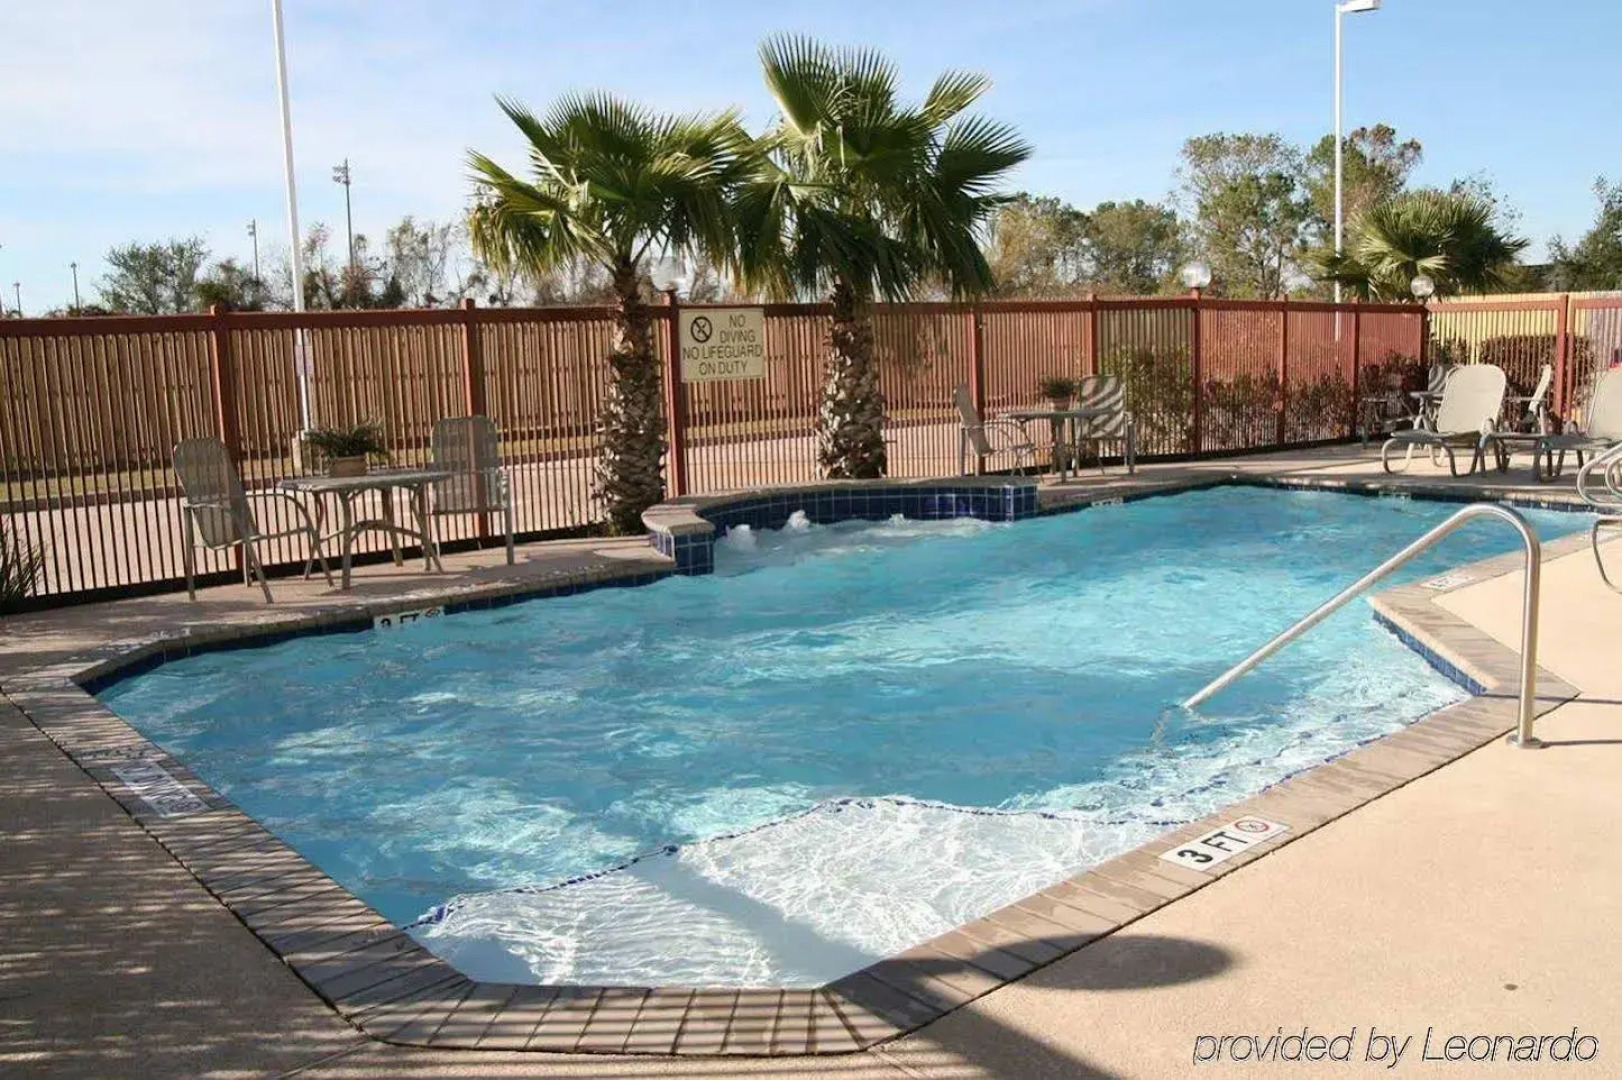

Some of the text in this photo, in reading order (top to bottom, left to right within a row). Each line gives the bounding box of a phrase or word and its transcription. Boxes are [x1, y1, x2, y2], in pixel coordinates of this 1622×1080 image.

[729, 314, 745, 328] NO
[720, 329, 756, 343] DIVING
[683, 344, 763, 360] NO LIFEGUARD
[699, 360, 747, 376] ON DUTY
[1177, 831, 1249, 863] 3 FT
